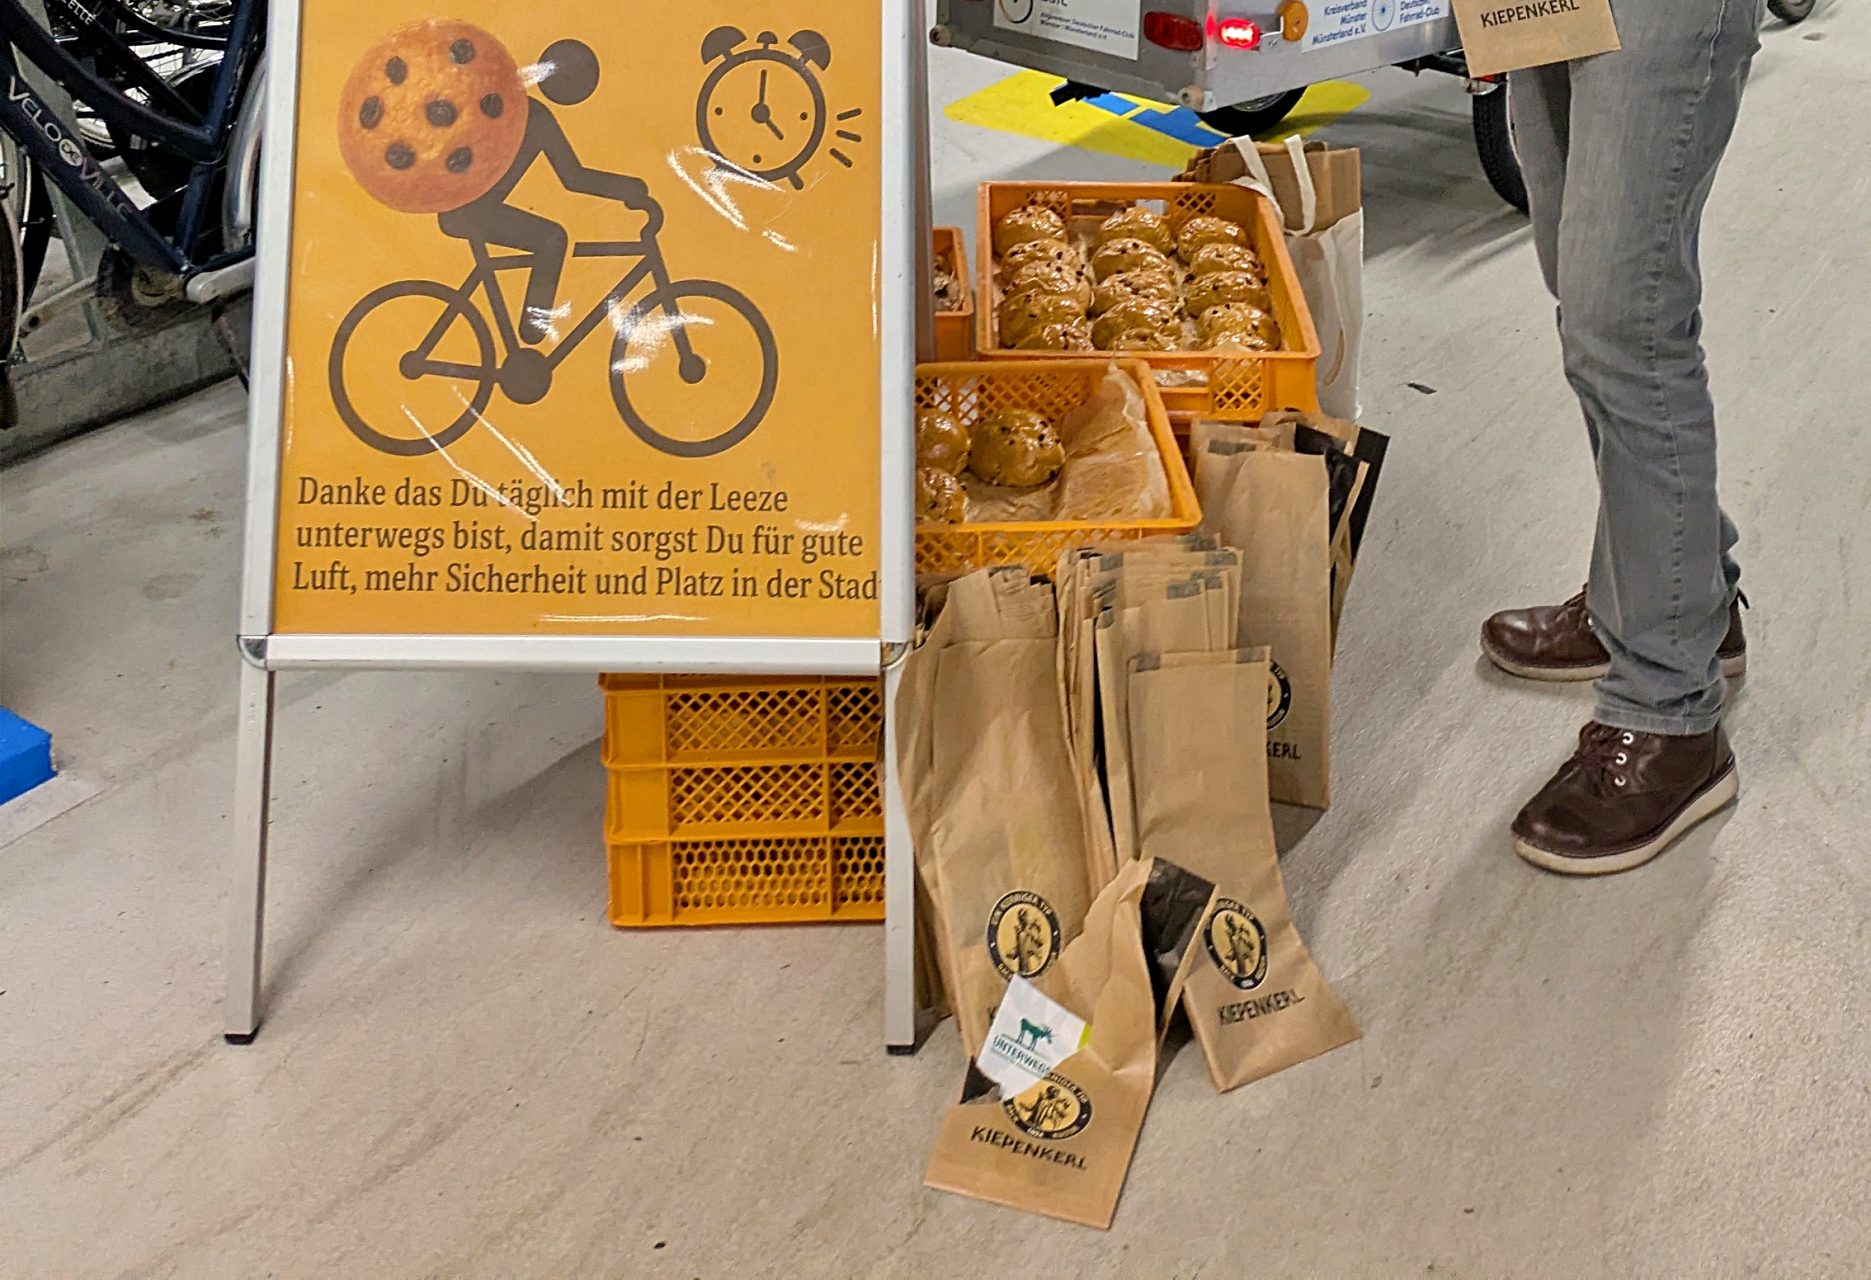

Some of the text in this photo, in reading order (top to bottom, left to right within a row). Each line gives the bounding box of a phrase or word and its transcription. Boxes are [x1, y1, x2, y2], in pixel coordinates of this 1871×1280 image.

[9, 75, 62, 142] VELO
[297, 477, 788, 516] Danke das Du täglich mit der Leeze
[296, 521, 864, 564] unterwegs bist, damit sorgst Du für gute
[293, 560, 882, 600] Luft, mehr Sicherheit und Platz in der Stad
[1218, 988, 1306, 1026] KIEPENKERL
[970, 1125, 1088, 1170] KIEPENKERL
